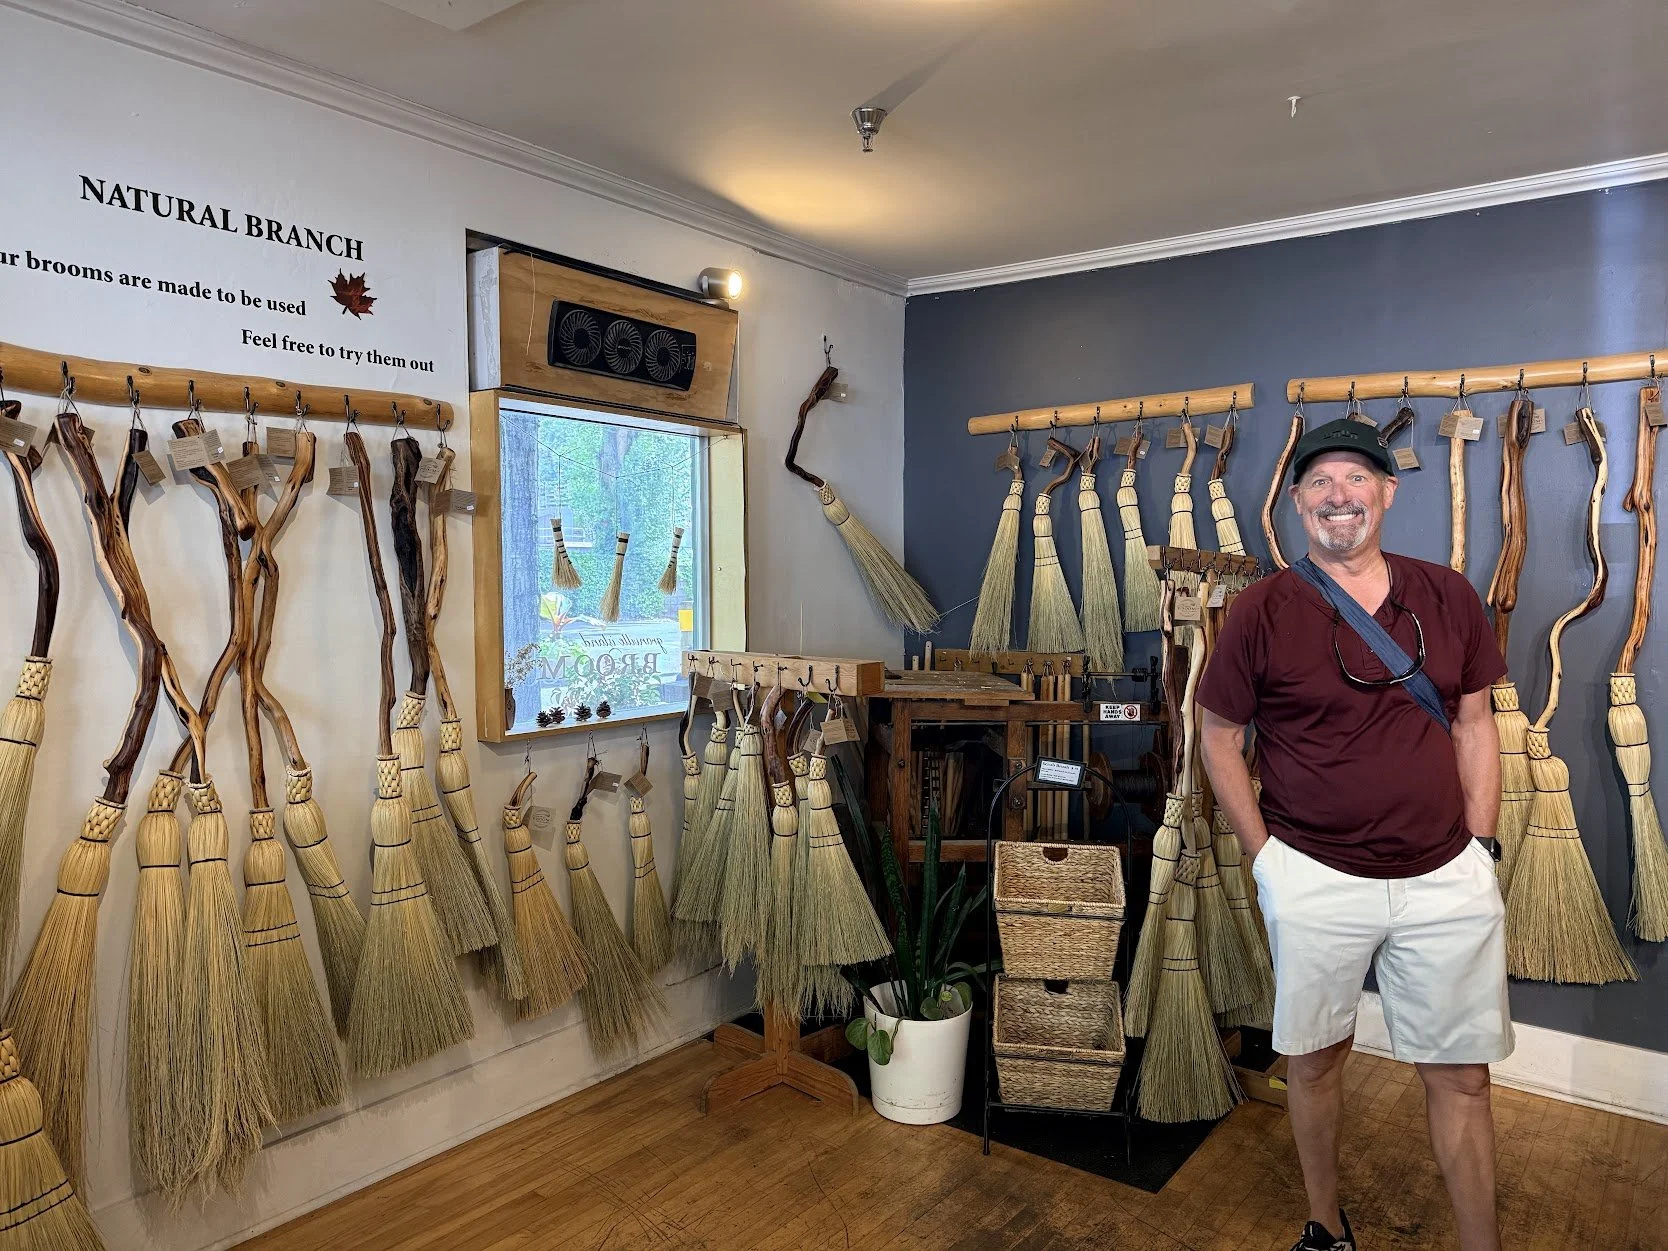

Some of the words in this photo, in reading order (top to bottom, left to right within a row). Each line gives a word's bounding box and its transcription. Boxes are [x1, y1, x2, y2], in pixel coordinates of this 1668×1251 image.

[79, 174, 238, 233] NATURAL
[244, 213, 364, 262] BRANCH
[24, 250, 114, 283] brooms
[118, 273, 152, 290] are
[157, 280, 212, 300] made
[216, 287, 236, 304] to
[240, 289, 262, 309] be
[266, 299, 306, 316] used
[241, 328, 277, 349] Feel
[281, 334, 315, 355] free
[318, 343, 335, 358] to
[338, 346, 363, 366] try
[366, 350, 407, 369] them
[409, 359, 434, 373] out
